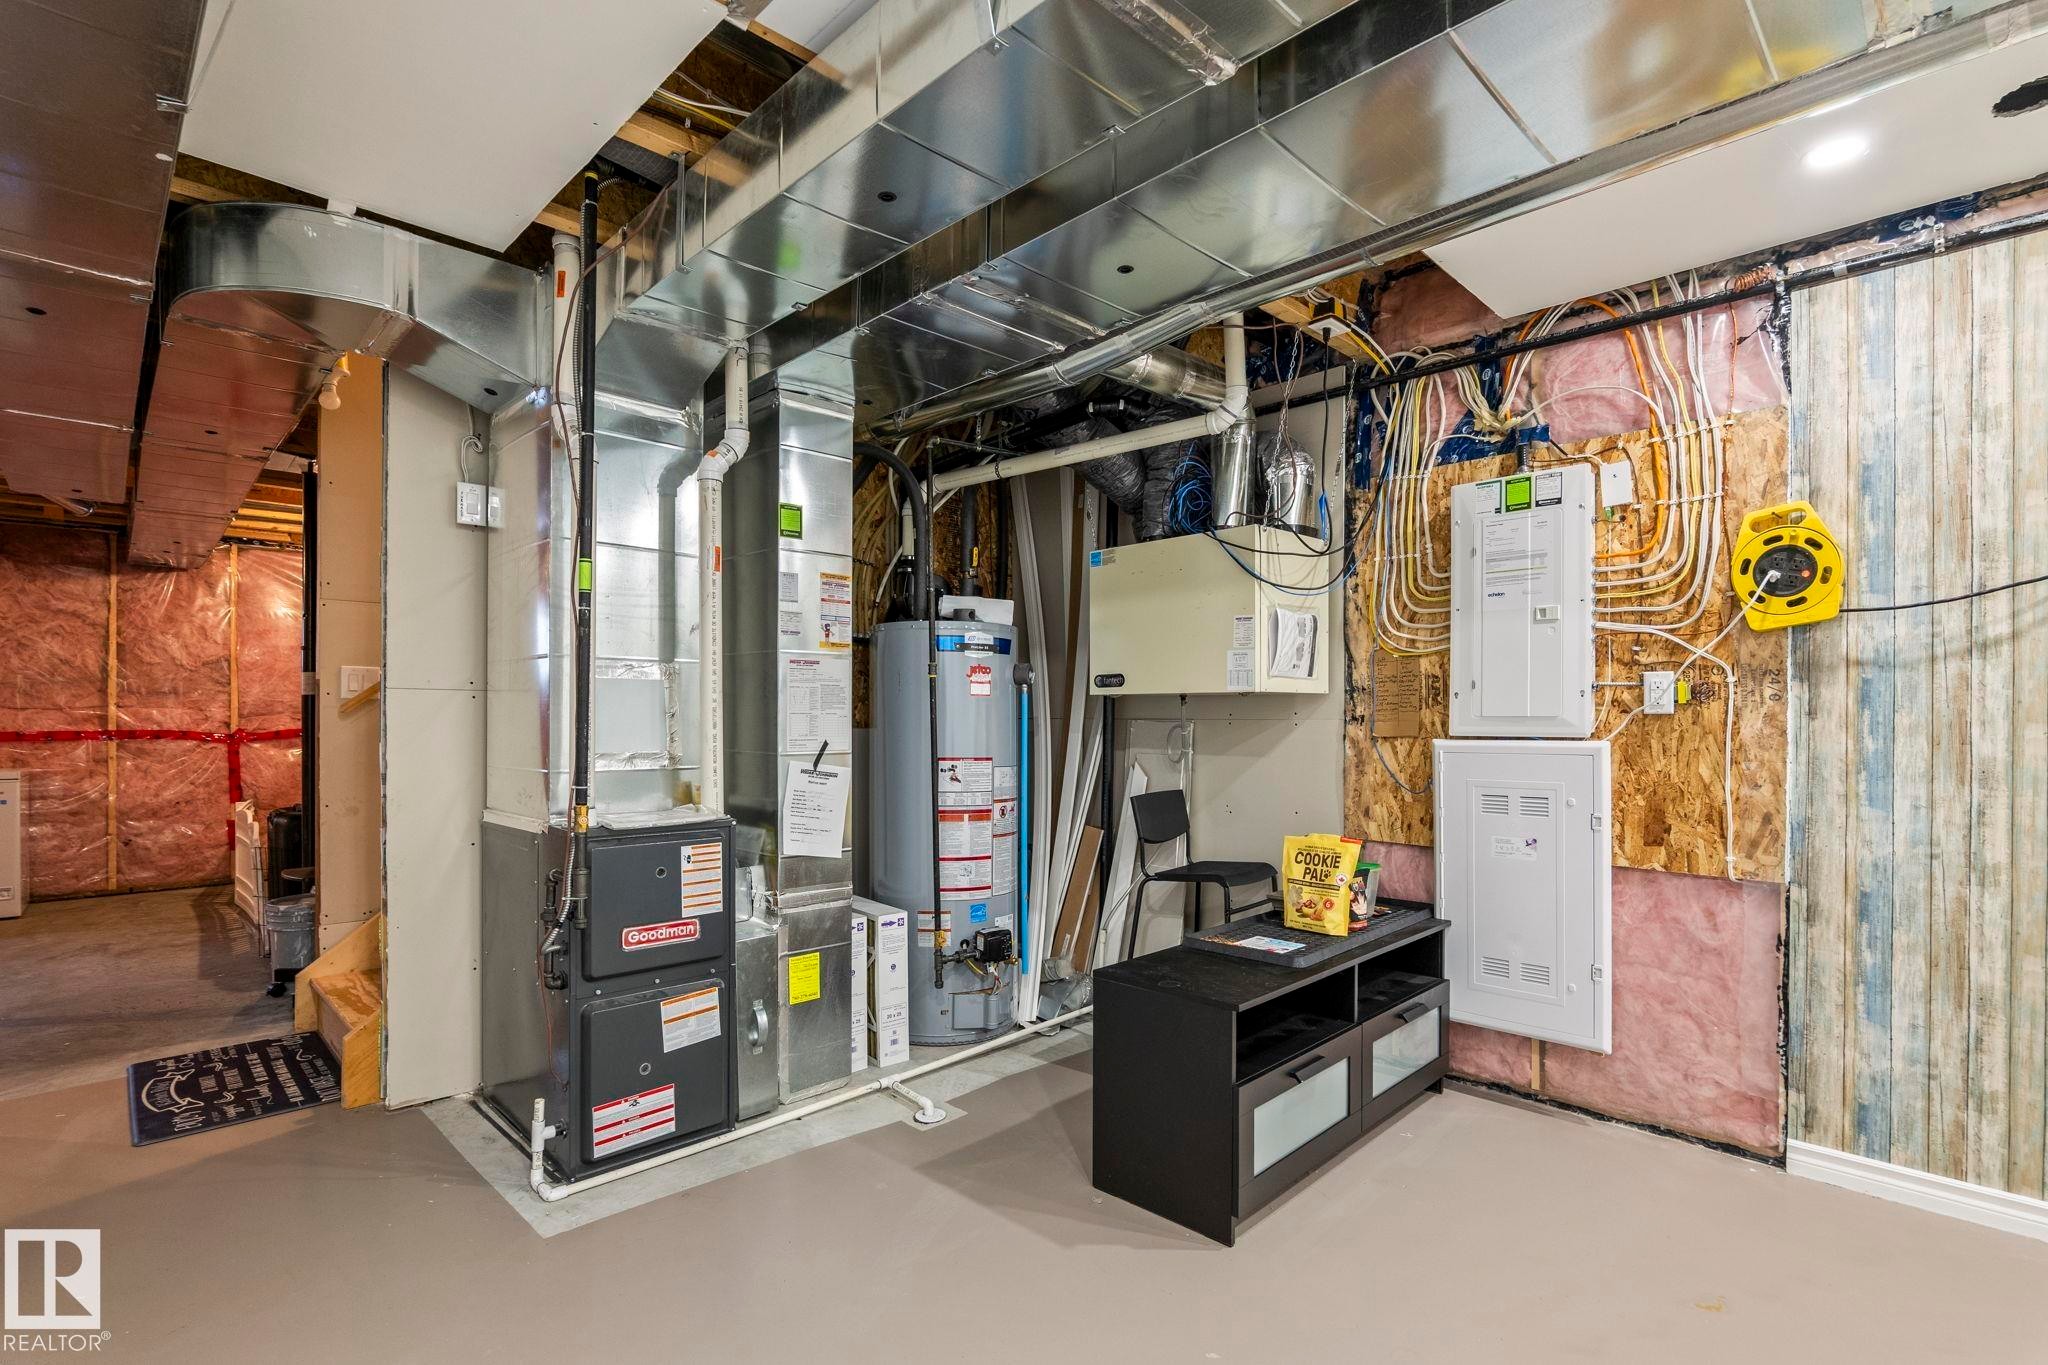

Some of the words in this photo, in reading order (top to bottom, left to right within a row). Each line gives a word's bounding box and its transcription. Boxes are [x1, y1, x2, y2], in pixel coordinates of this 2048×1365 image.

[1103, 676, 1123, 685] fantech
[1294, 851, 1342, 869] COOKIE
[1302, 866, 1325, 882] PAL
[628, 924, 694, 943] Goodman
